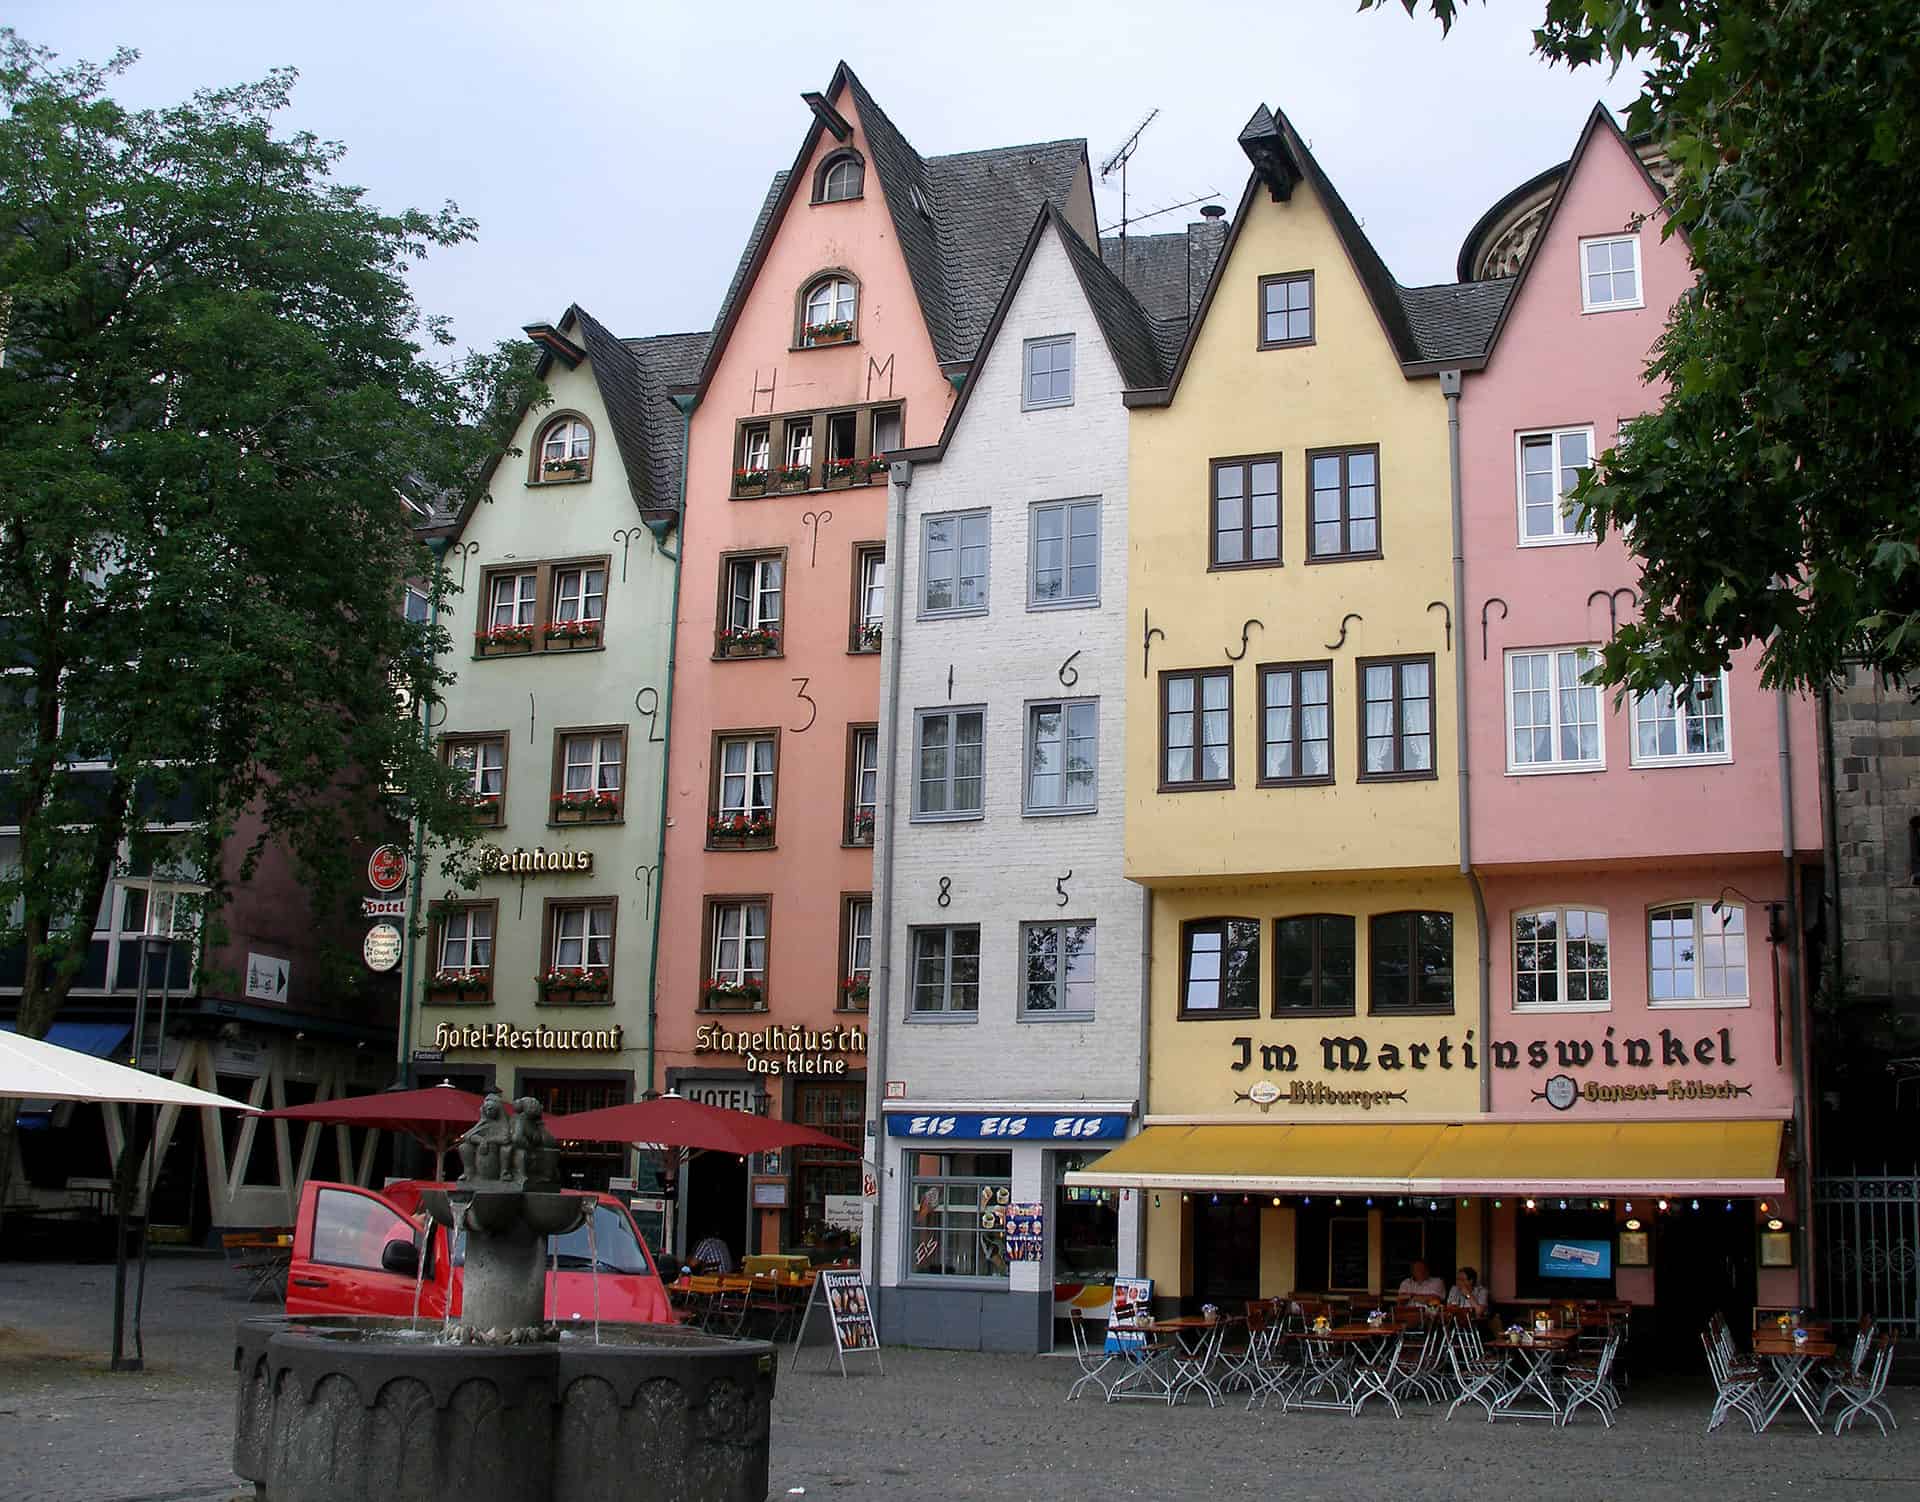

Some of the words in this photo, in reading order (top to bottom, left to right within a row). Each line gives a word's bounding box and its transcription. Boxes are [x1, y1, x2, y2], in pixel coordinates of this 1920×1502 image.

[1058, 649, 1081, 687] 6
[789, 677, 818, 733] 3
[937, 876, 952, 908] 8
[1056, 869, 1073, 907] 5
[434, 1022, 623, 1052] Hotel-Restaurant
[1230, 1036, 1299, 1071] Im
[1319, 1026, 1736, 1071] Martinswinkel
[746, 1052, 780, 1075] das
[786, 1053, 845, 1075] kleine
[688, 1089, 754, 1113] HOTEL
[1288, 1080, 1392, 1110] Bitburger
[1583, 1081, 1657, 1103] Ganser
[1667, 1079, 1740, 1101] Kölsch
[908, 1116, 957, 1136] EIS
[979, 1116, 1028, 1136] EIS
[1053, 1117, 1103, 1138] EIS
